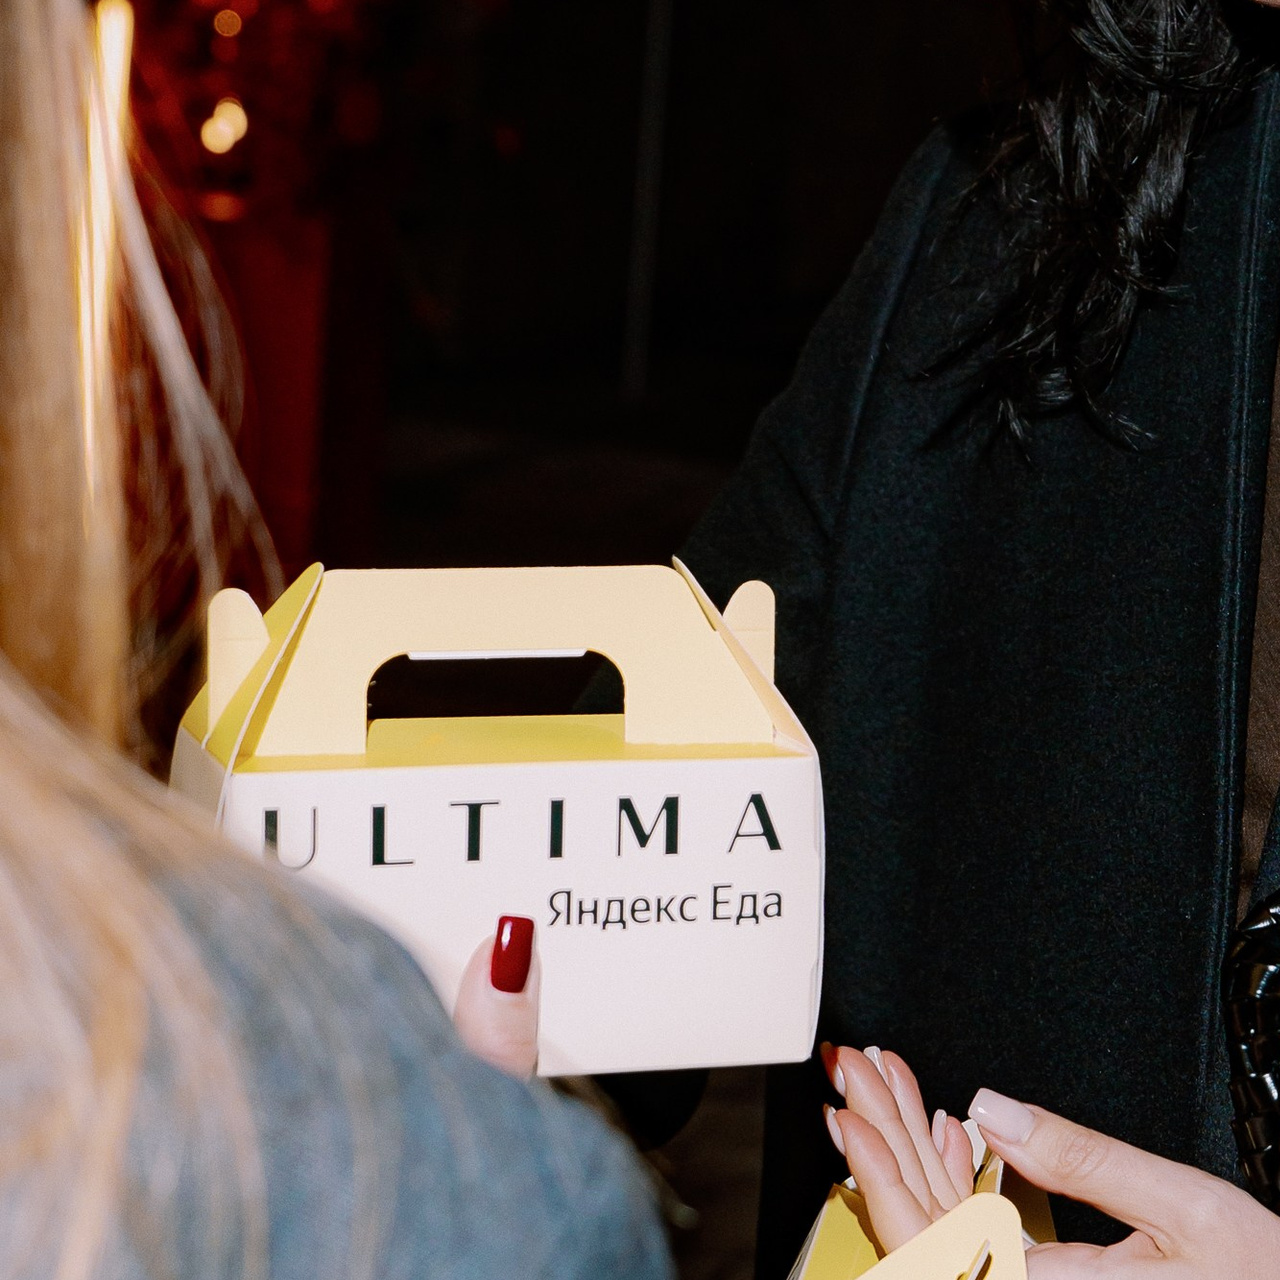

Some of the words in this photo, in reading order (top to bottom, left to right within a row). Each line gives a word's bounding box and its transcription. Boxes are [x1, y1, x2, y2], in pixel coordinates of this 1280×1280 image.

[264, 793, 782, 871] ULTIMA
[549, 890, 698, 930] Яндекс
[711, 883, 783, 926] Еда
